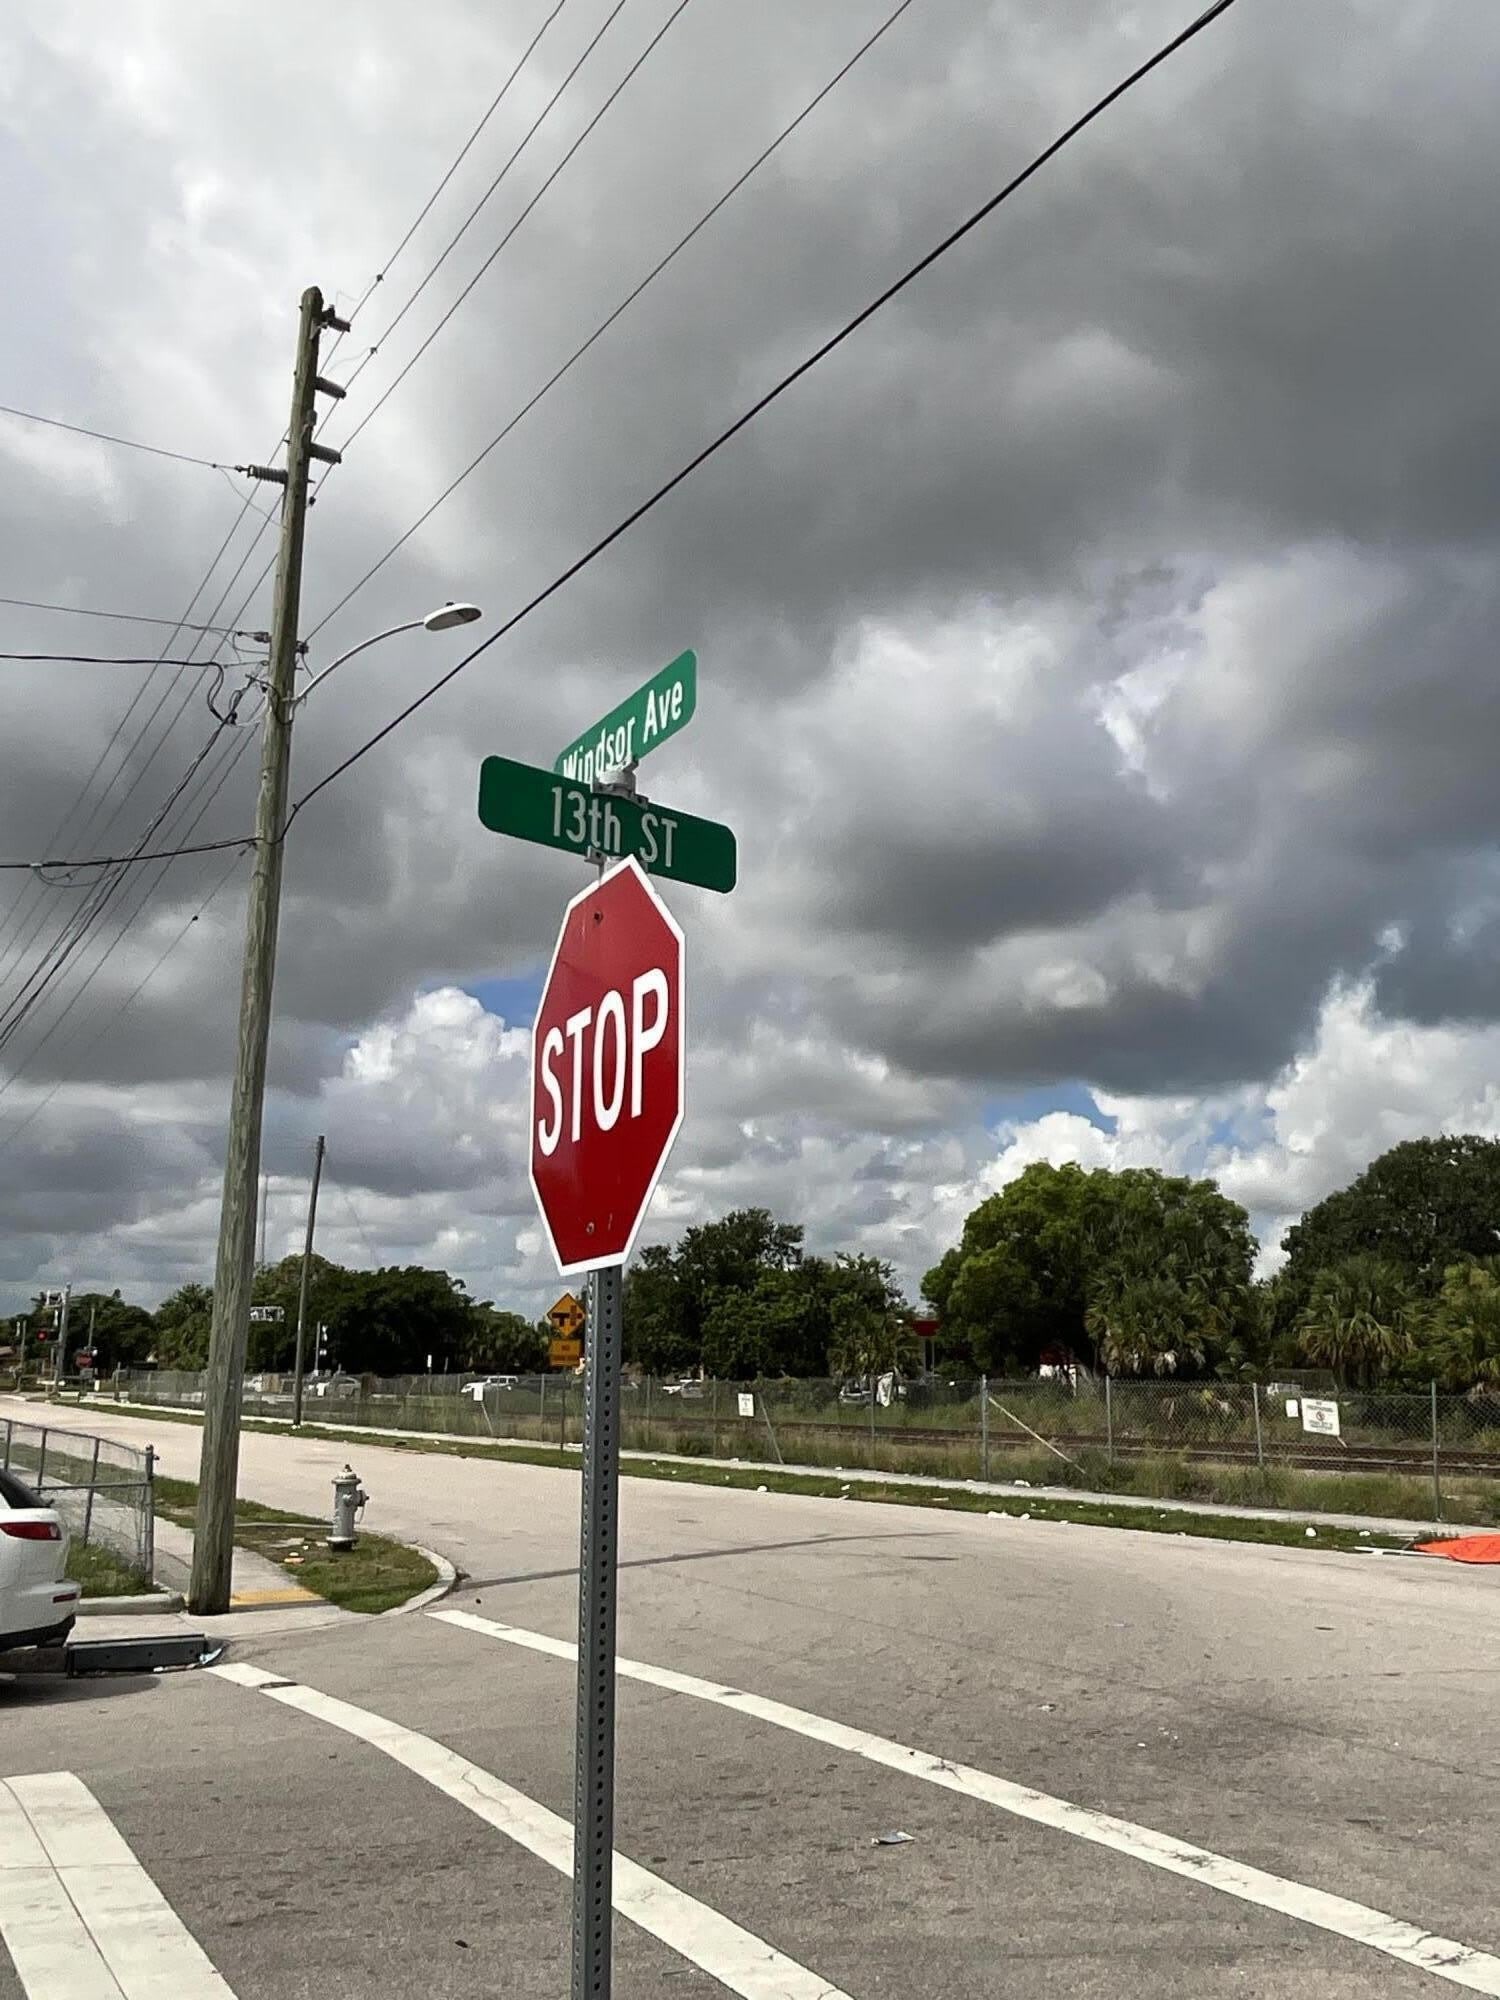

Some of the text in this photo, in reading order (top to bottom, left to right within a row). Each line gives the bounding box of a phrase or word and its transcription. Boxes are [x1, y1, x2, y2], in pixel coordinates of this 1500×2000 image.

[563, 680, 683, 784] Windsor Ave
[551, 787, 678, 868] 13th ST
[538, 967, 669, 1157] STOP
